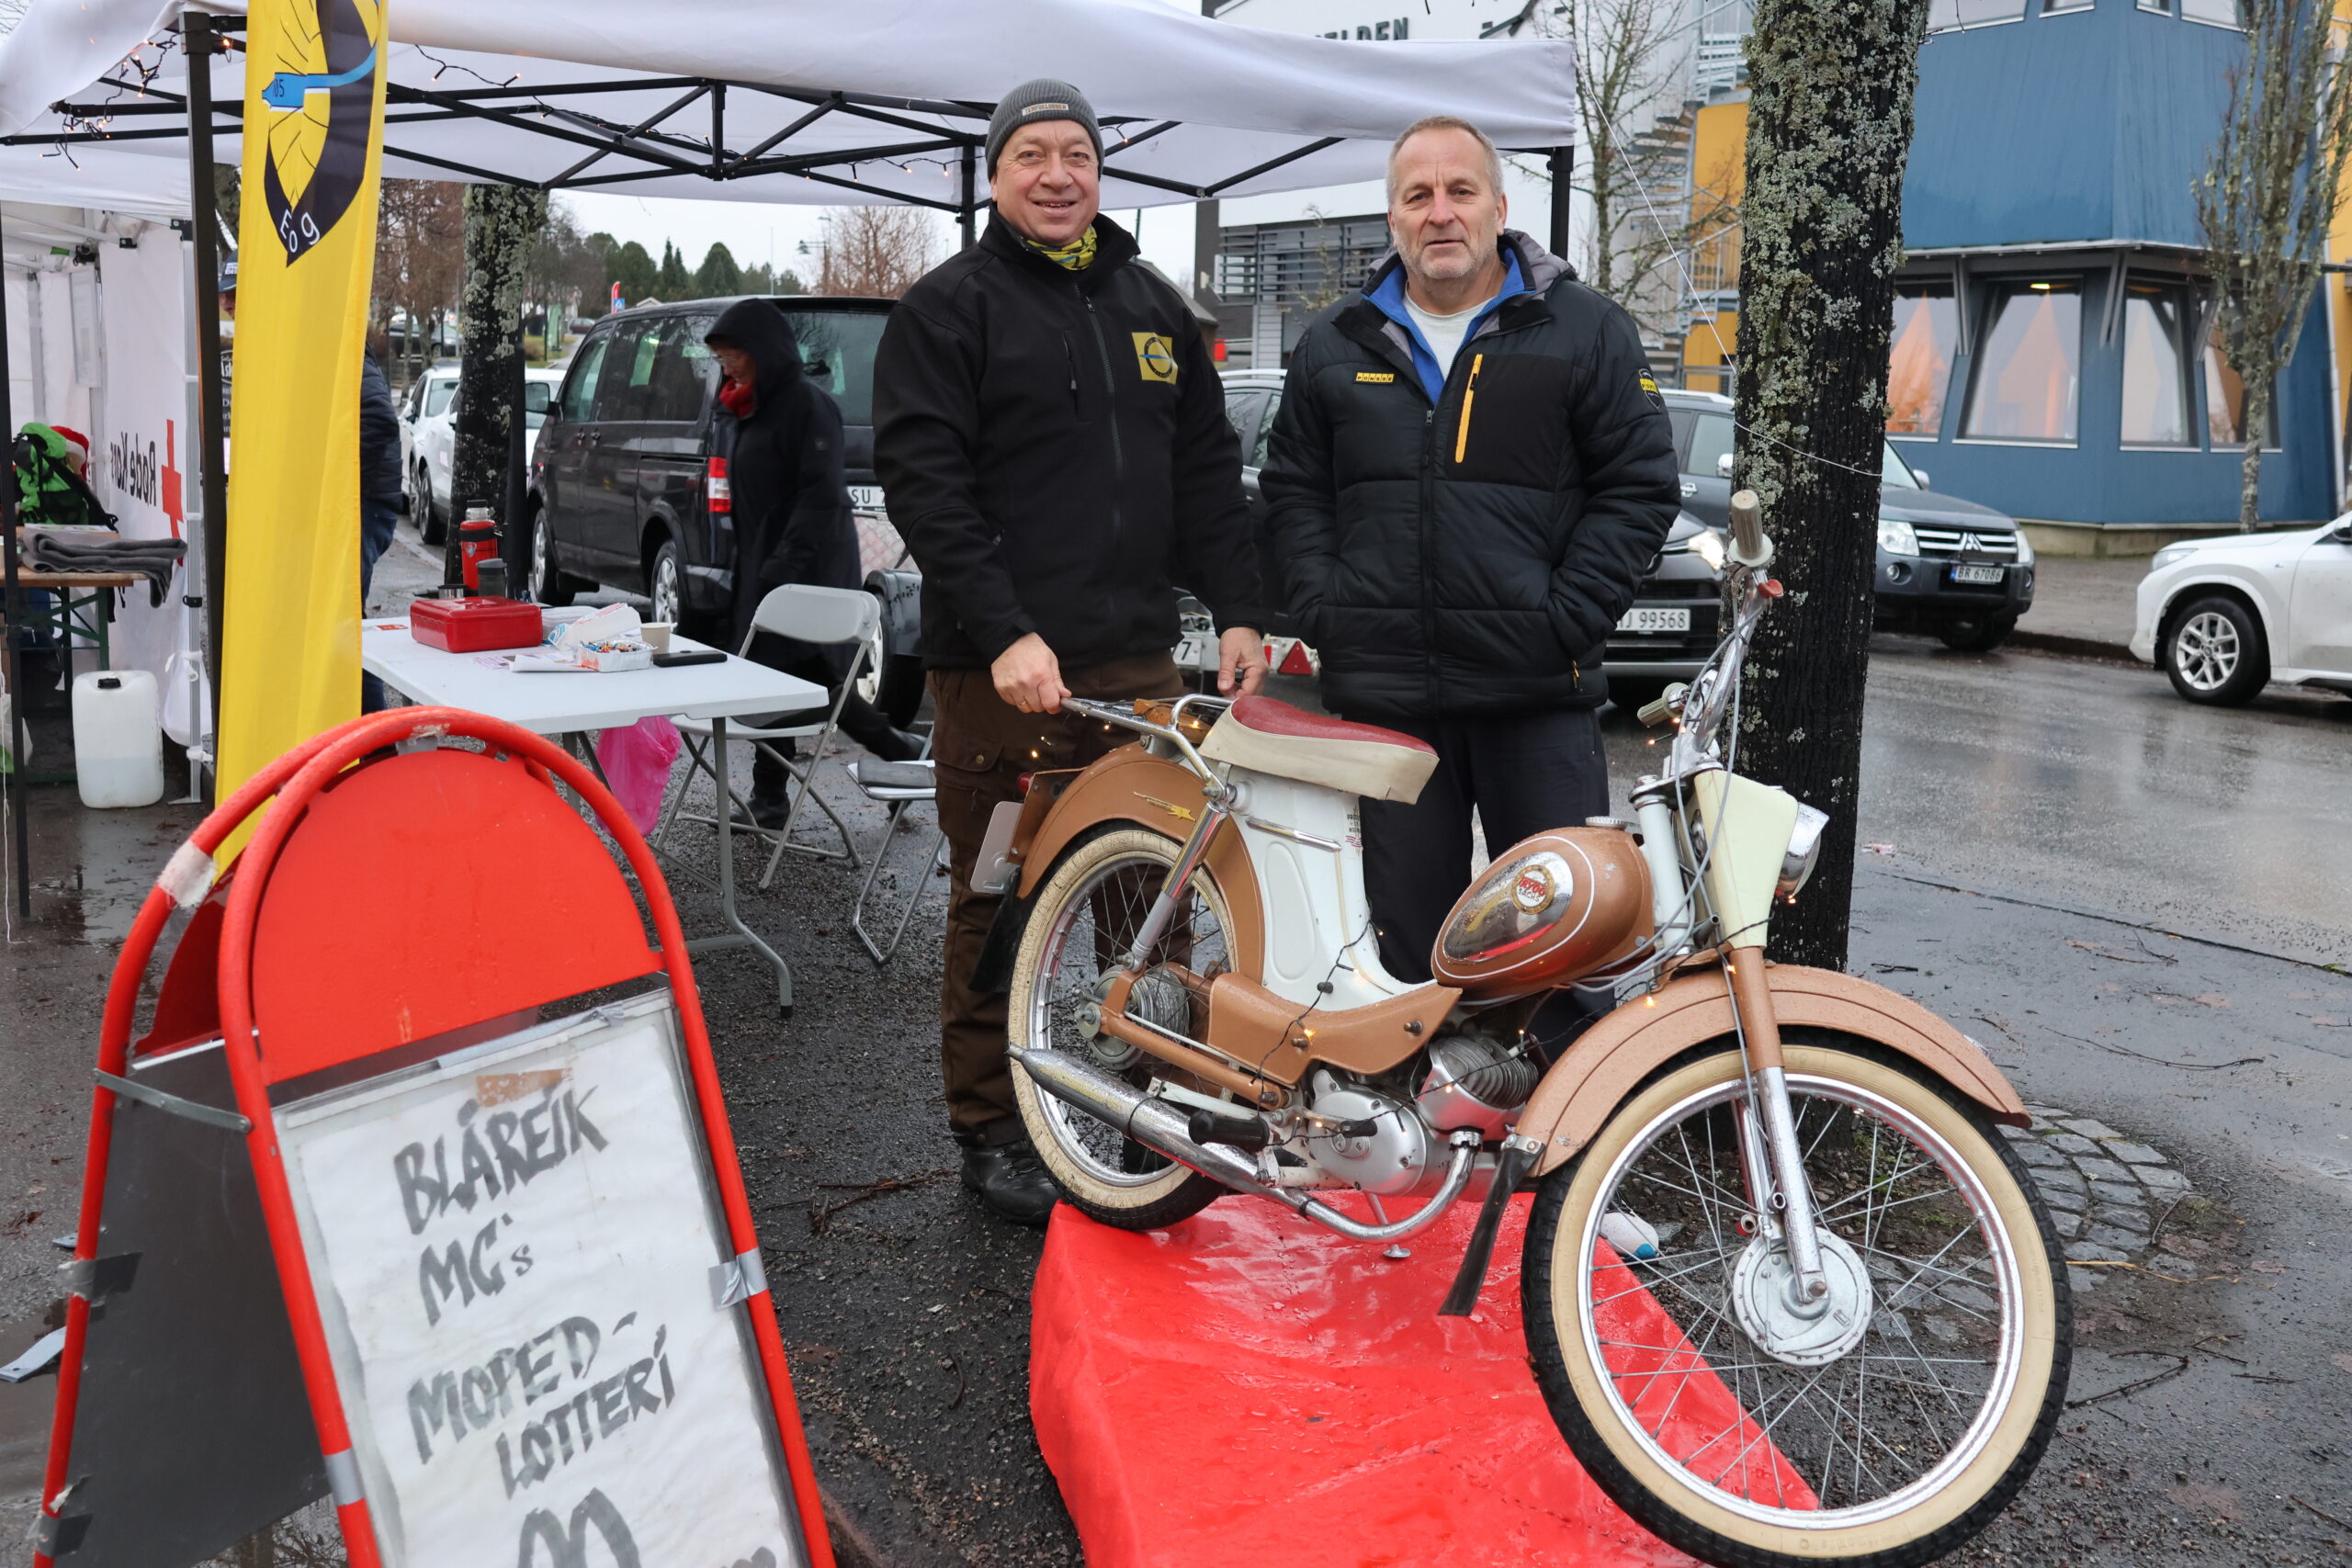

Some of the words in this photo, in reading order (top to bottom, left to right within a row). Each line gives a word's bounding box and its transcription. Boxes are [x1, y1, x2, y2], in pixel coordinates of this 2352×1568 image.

[1958, 567, 1971, 579] BR
[1973, 569, 2001, 581] 67086
[1639, 612, 1685, 628] 99568
[1519, 888, 1541, 901] SACHS
